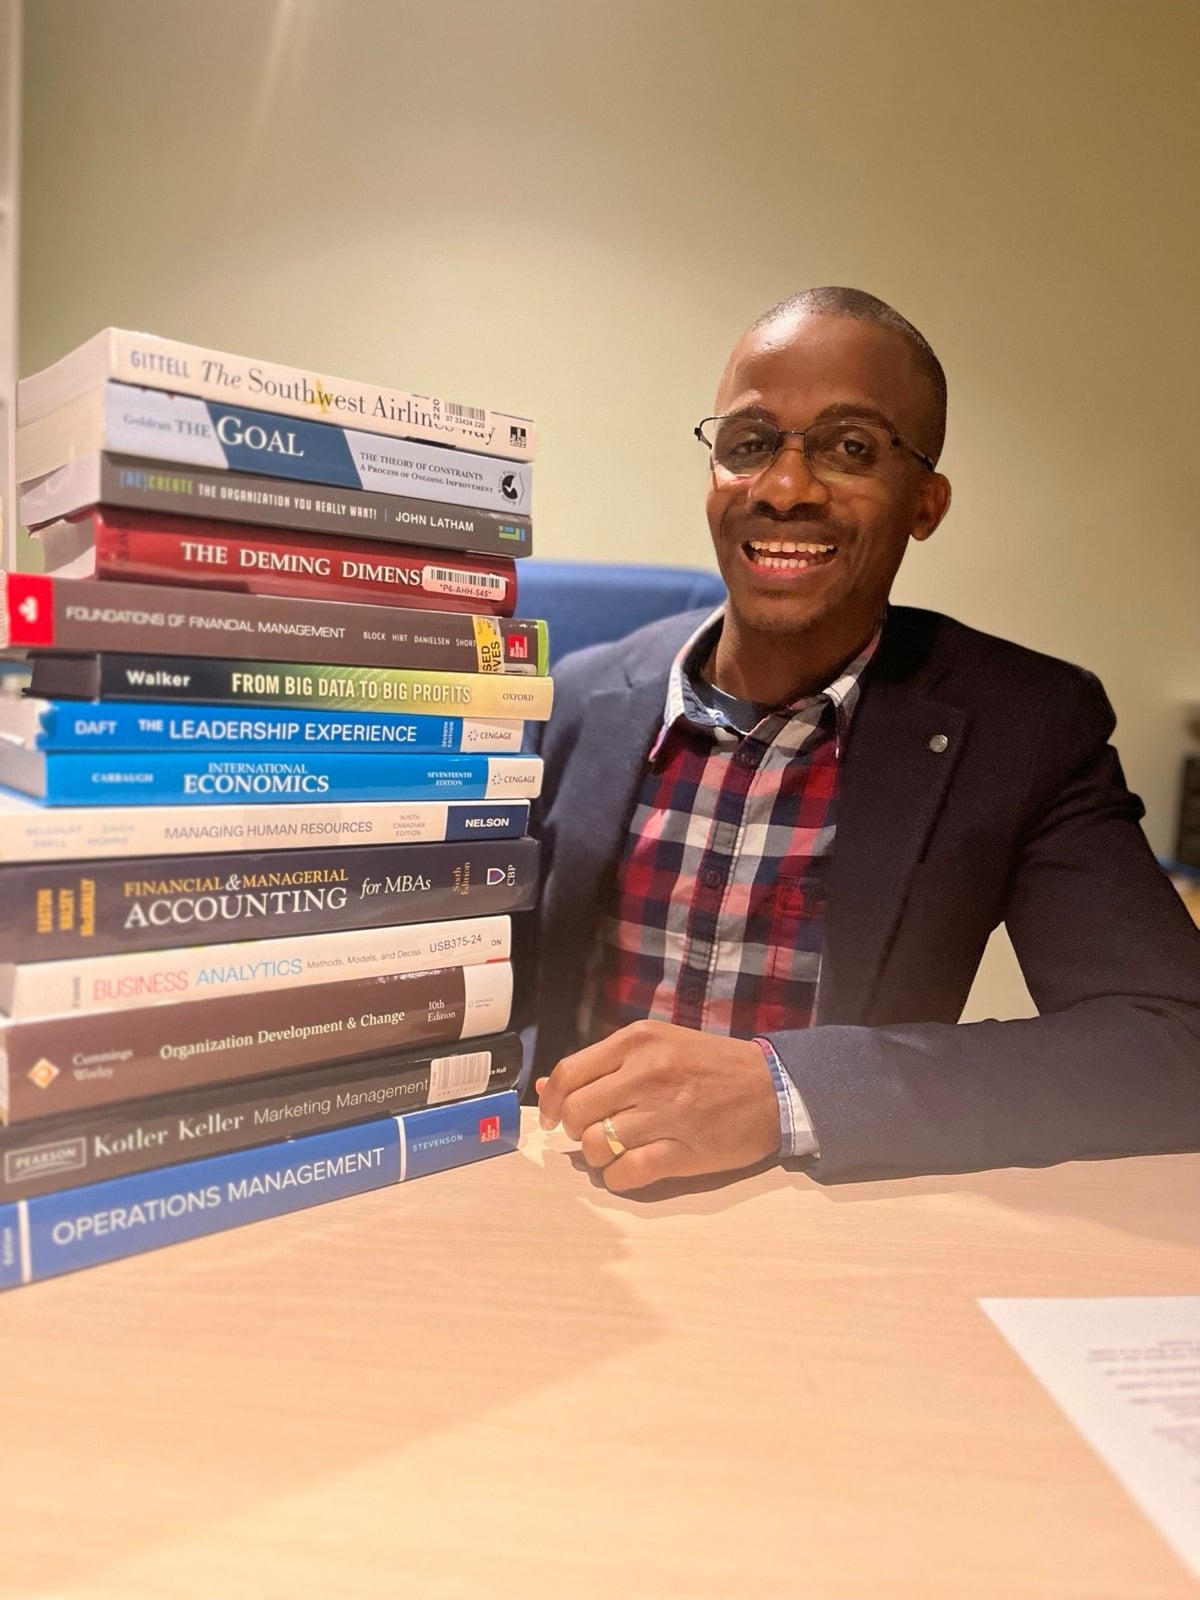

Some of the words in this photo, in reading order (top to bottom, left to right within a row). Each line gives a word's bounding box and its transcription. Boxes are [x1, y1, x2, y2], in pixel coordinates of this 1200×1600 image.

[130, 351, 190, 378] GITTELL
[201, 359, 242, 389] The
[248, 367, 366, 415] Southwest
[433, 398, 441, 420] 220
[175, 418, 212, 438] THE
[216, 415, 304, 457] GOAL
[360, 451, 377, 462] THE
[380, 454, 414, 469] THEORY
[415, 462, 427, 471] OF
[428, 463, 484, 481] CONSTRAINTS
[360, 464, 366, 472] A
[198, 483, 217, 499] THE
[220, 485, 291, 508] ORGANIZATION
[294, 498, 312, 511] YOU
[315, 500, 346, 517] REALLY
[350, 505, 377, 520] WANT!
[395, 511, 427, 526] JOHN
[430, 515, 474, 533] LATHAM
[180, 541, 228, 565] THE
[239, 548, 331, 577] DEMING
[66, 605, 165, 627] FOUNDATIONS
[168, 613, 186, 627] OF
[189, 615, 255, 633] FINANCIAL
[258, 621, 346, 639] MANAGEMENT
[363, 631, 386, 641] BLOCK
[392, 633, 408, 642] HIRT
[414, 635, 450, 646] DANIELSEN
[126, 669, 191, 687] Walker
[231, 672, 280, 695] FROM
[285, 675, 313, 696] BIG
[318, 678, 355, 698] DATA
[360, 680, 378, 700] TO
[383, 681, 408, 700] BIG
[413, 683, 472, 704] PROFITS
[502, 692, 534, 702] OXFORD
[74, 720, 118, 735] DAFT
[138, 718, 164, 732] THE
[169, 719, 300, 740] LEADERSHIP
[304, 723, 418, 743] EXPERIENCE
[480, 731, 512, 741] CENGAGE
[208, 762, 309, 774] INTERNATIONAL
[427, 771, 473, 779] SEVENTEENTH
[183, 774, 330, 794] ECONOMICS
[435, 779, 463, 787] EDITION
[504, 775, 537, 784] CENGAGE
[165, 825, 244, 840] MANAGING
[247, 823, 298, 838] HUMAN
[301, 821, 373, 836] RESOURCES
[393, 821, 426, 830] CANADIAN
[396, 829, 421, 837] EDITION
[465, 817, 510, 829] NELSON
[124, 876, 224, 897] FINANCIAL
[225, 874, 242, 892] &
[242, 868, 349, 889] MANAGERIAL
[452, 867, 462, 893] Sixth
[461, 862, 471, 895] Edition
[506, 864, 517, 887] CBP
[360, 878, 382, 900] for
[385, 874, 432, 894] MBAs
[123, 886, 348, 929] ACCOUNTING
[429, 933, 482, 953] USB375-24
[93, 970, 189, 1001] BUSINESS
[196, 958, 303, 986] ANALYTICS
[307, 957, 345, 970] Methods,
[347, 953, 378, 965] Models,
[380, 951, 396, 961] and
[427, 1010, 456, 1023] Edition
[428, 1000, 445, 1012] 10th
[160, 1034, 253, 1060] Organization
[257, 1019, 343, 1044] Development
[347, 1016, 357, 1030] &
[360, 1011, 406, 1028] Change
[72, 1049, 134, 1066] Cummings
[15, 1147, 76, 1169] PEARSON
[94, 1127, 168, 1158] Kotler
[178, 1113, 244, 1141] Keller
[254, 1098, 331, 1126] Marketing
[336, 1078, 429, 1109] Management
[412, 1133, 464, 1152] STEVENSON
[52, 1185, 222, 1246] OPERATIONS
[228, 1146, 385, 1202] MANAGEMENT
